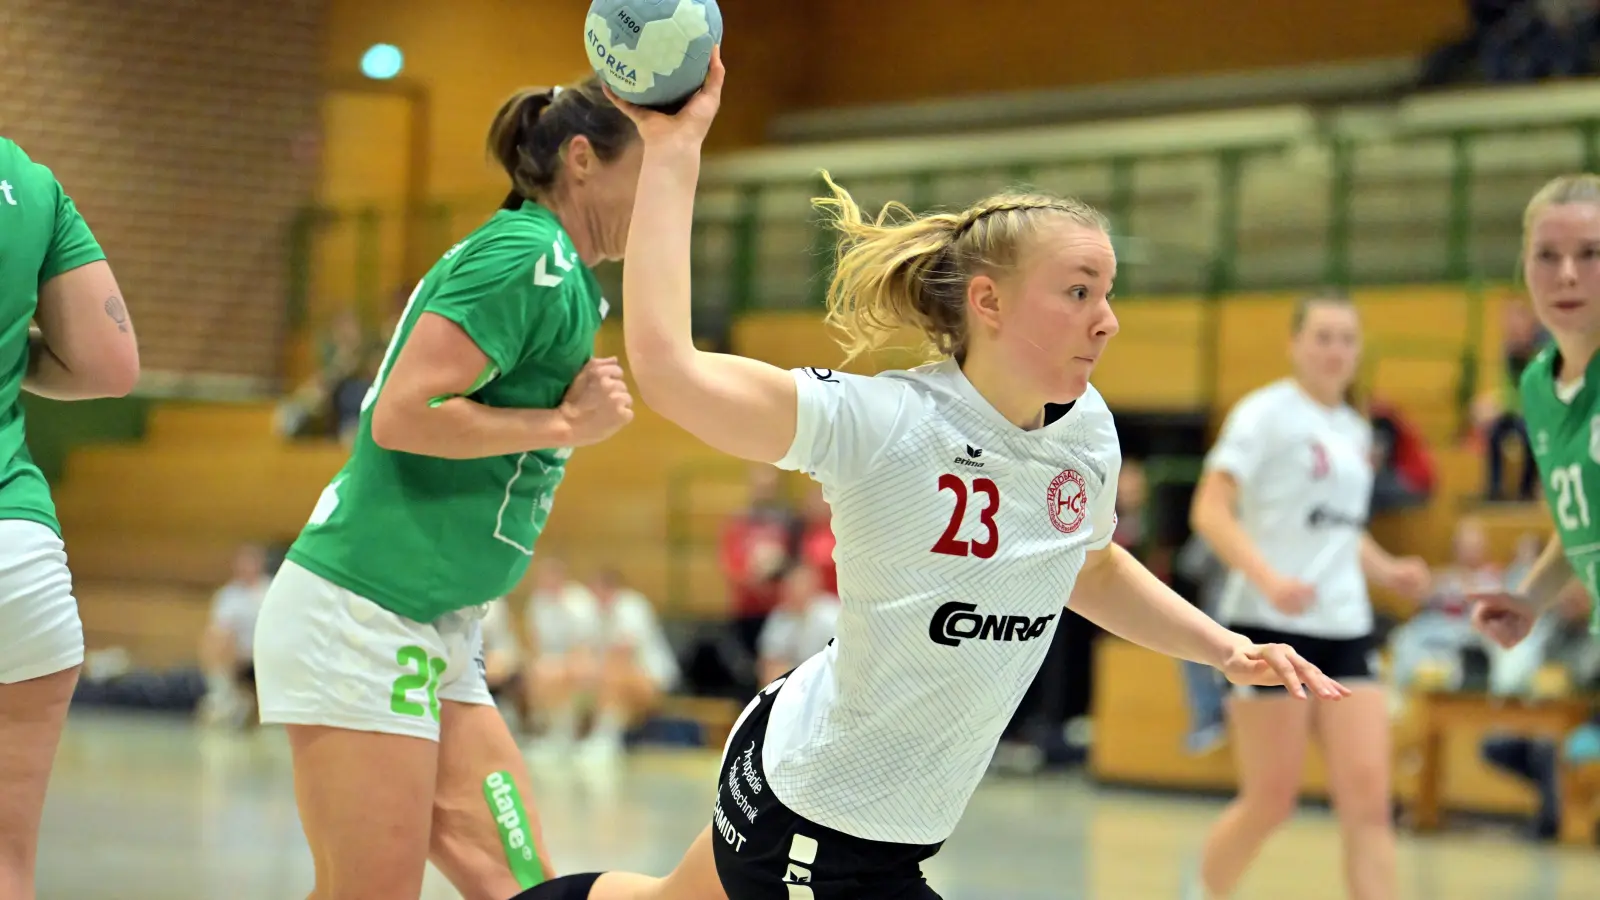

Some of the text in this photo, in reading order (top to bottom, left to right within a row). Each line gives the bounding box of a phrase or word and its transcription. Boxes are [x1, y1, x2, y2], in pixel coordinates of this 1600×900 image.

[617, 10, 641, 34] H500
[587, 29, 637, 81] ATORKA
[953, 456, 985, 468] erima
[930, 473, 1000, 559] 23
[1057, 488, 1082, 516] HC
[1550, 463, 1591, 531] 21
